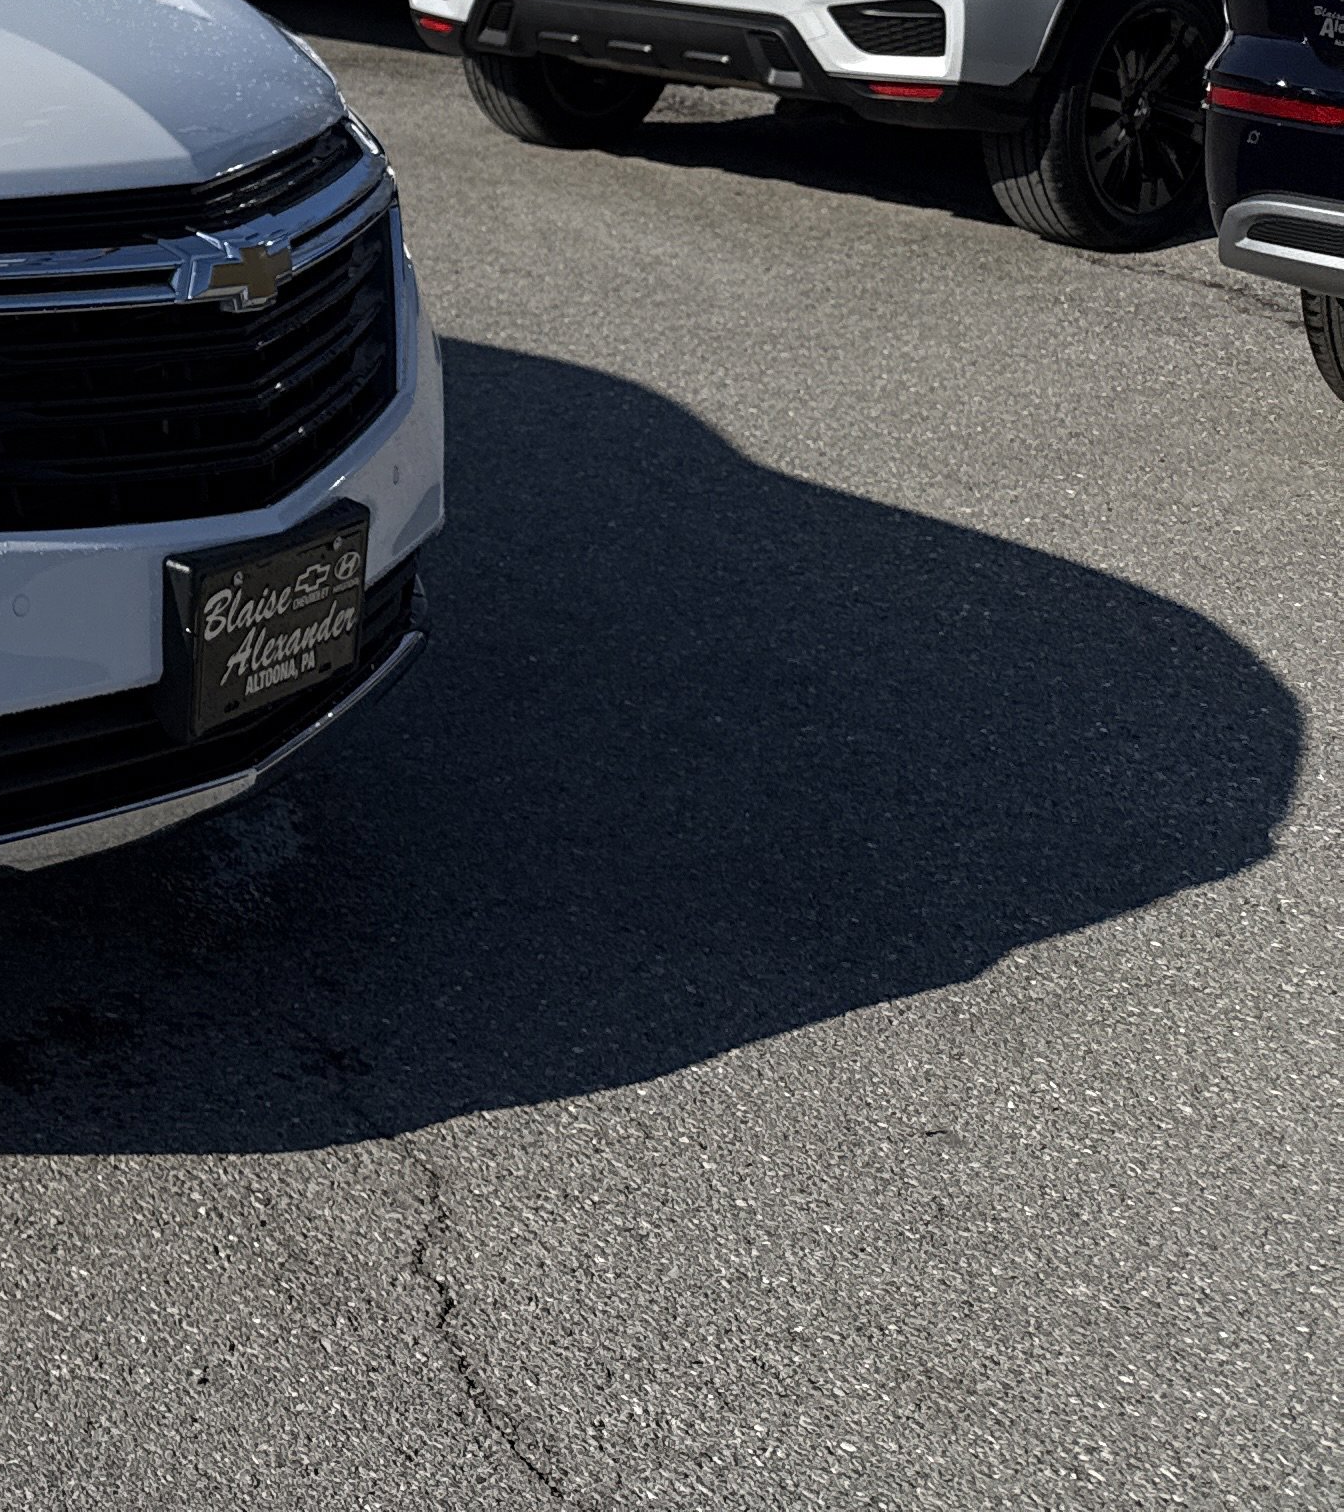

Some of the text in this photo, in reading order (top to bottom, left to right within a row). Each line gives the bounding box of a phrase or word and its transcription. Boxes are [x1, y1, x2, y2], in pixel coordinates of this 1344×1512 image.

[203, 585, 294, 641] Blaise
[220, 601, 355, 686] Alexander
[245, 650, 315, 695] ALTOONA, PA
